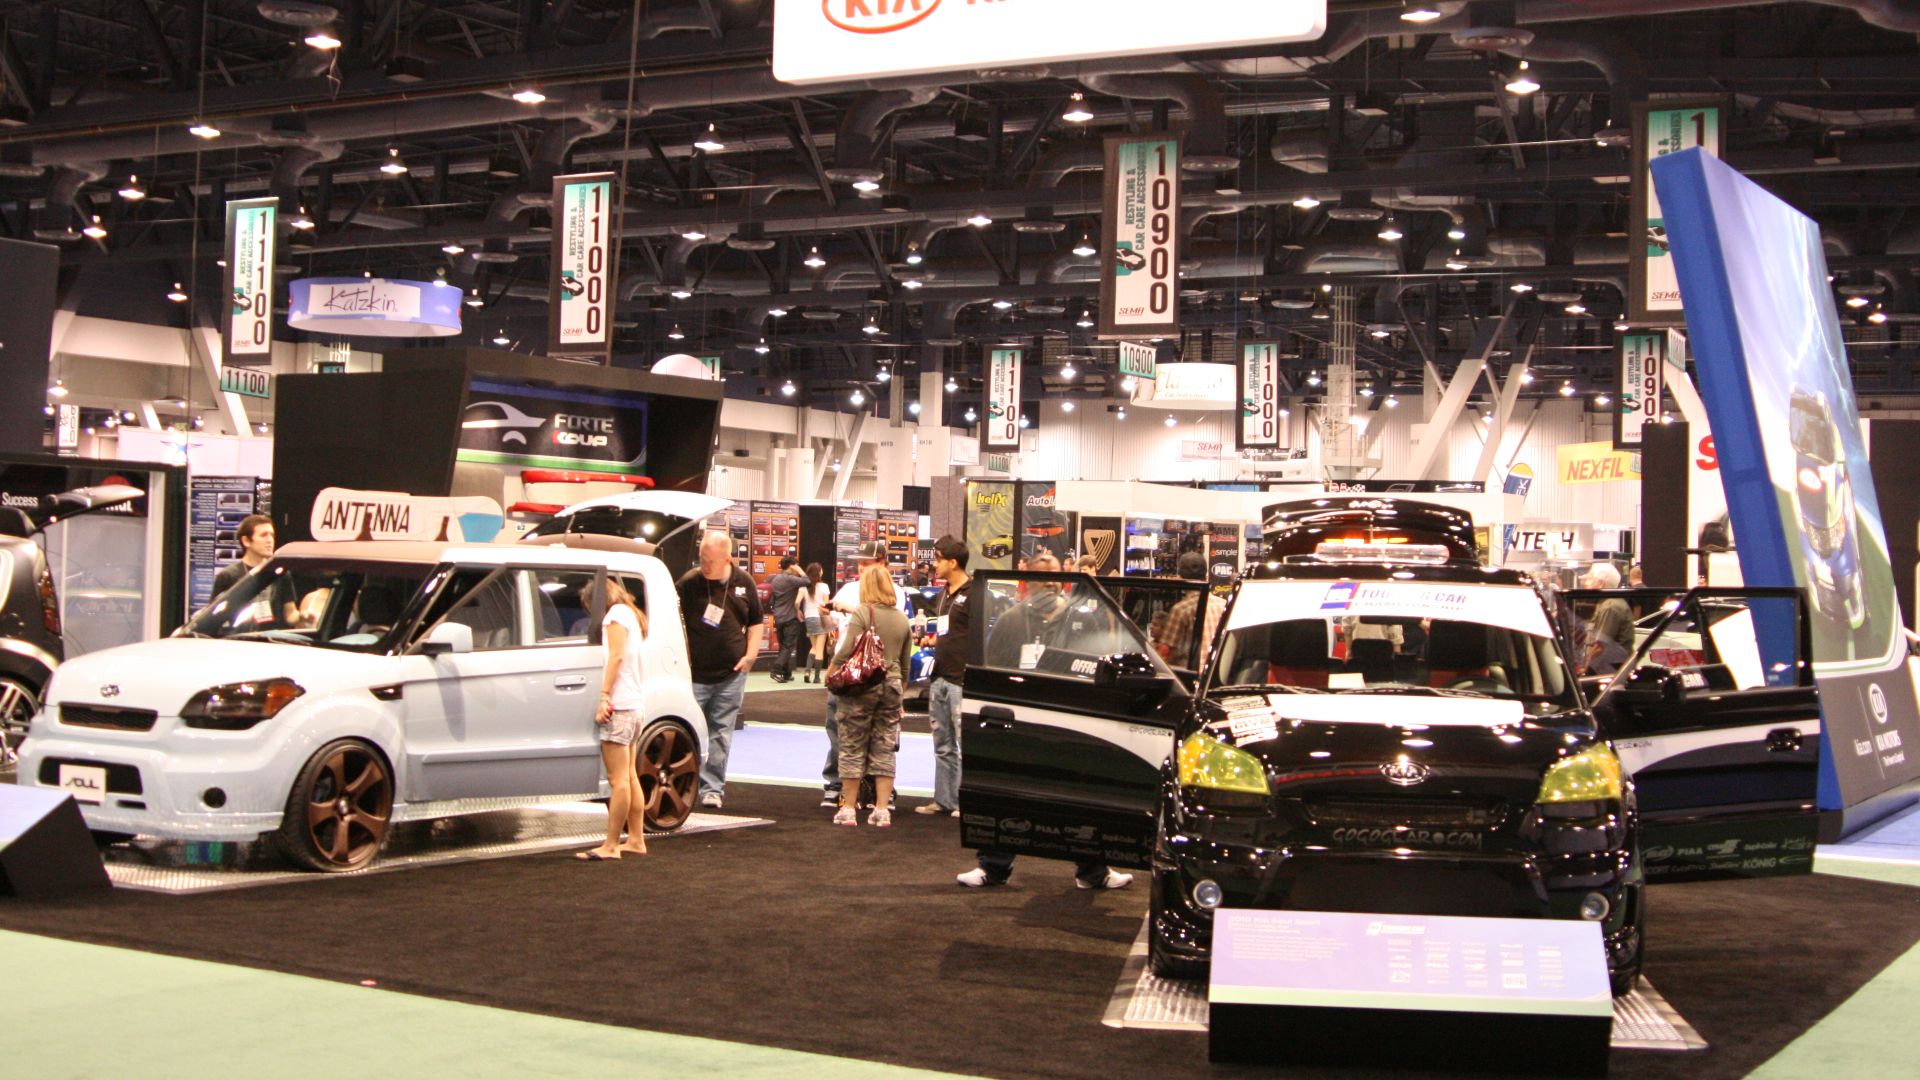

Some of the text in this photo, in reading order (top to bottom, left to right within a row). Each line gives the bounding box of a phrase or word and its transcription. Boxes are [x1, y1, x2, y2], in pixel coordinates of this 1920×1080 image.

[1126, 178, 1135, 224] RESTYLING
[1135, 144, 1146, 250] CAR CARE ACCESSORIES
[1150, 143, 1170, 314] 10900
[577, 236, 585, 258] CARE
[586, 185, 602, 334] 11000
[253, 210, 267, 345] 11100
[323, 285, 396, 312] Katzkin
[1123, 346, 1152, 374] 10900
[226, 369, 265, 394] 11100
[1263, 346, 1273, 438] 11000
[1644, 337, 1656, 423] 1090
[1006, 352, 1016, 439] 11100
[554, 413, 614, 433] FORTE
[1197, 442, 1222, 451] SEMA
[1567, 458, 1624, 480] NEXFIL
[2, 491, 38, 507] Success
[321, 500, 410, 533] ANTENNA
[1214, 566, 1234, 576] PAC
[1071, 658, 1098, 675] OFFIC
